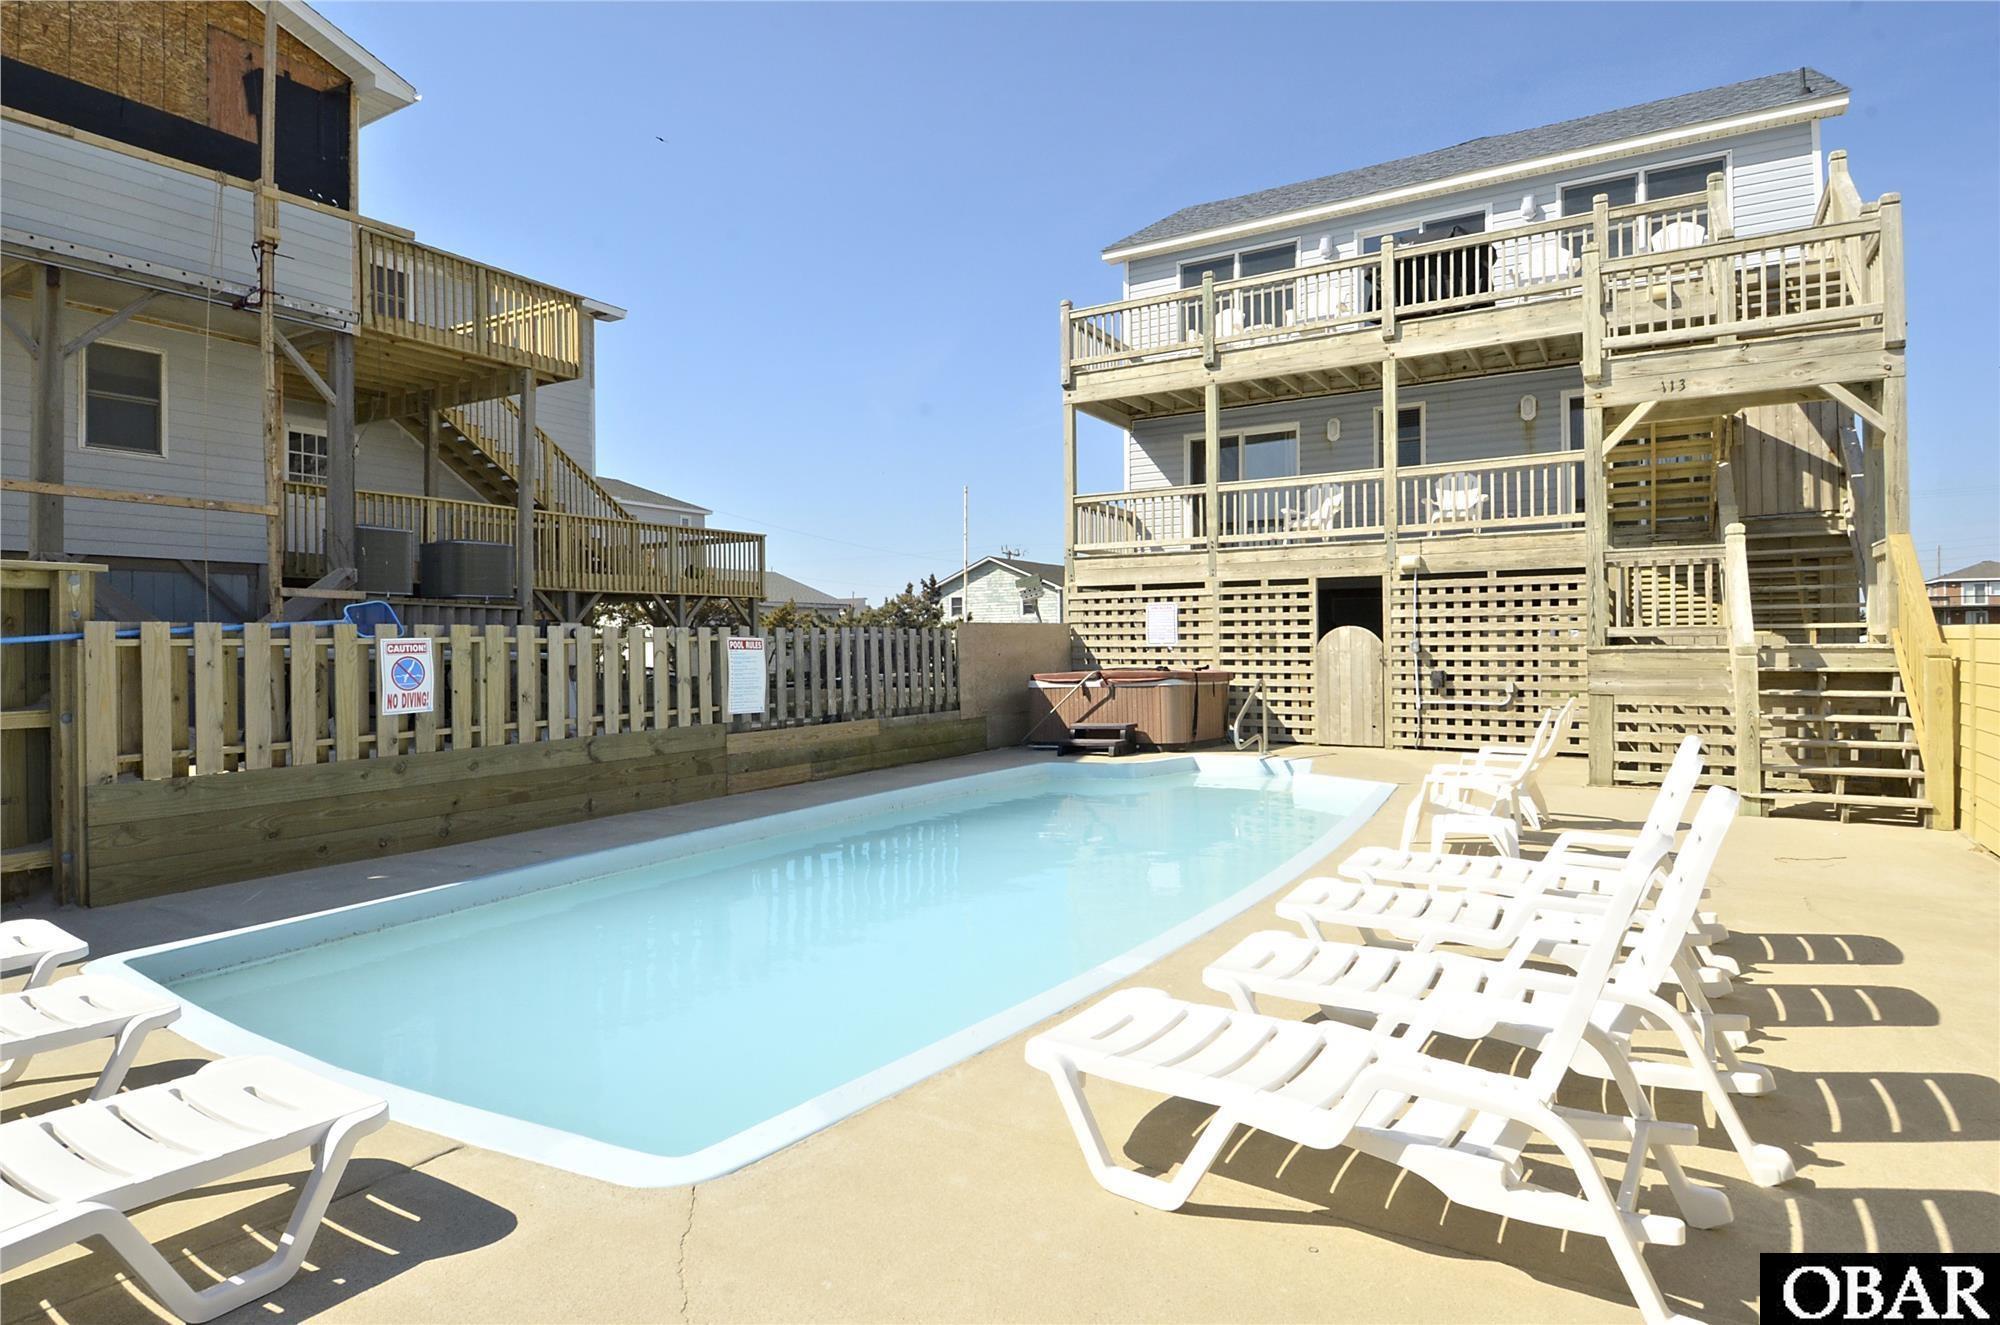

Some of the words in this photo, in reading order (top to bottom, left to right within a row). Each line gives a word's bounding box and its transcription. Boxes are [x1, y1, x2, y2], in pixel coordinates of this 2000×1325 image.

[1661, 378, 1686, 393] 113
[387, 644, 427, 653] CAUTION!
[730, 640, 744, 649] POOL
[746, 640, 762, 649] RULES
[387, 693, 398, 709] NO
[402, 692, 429, 708] DIVING!
